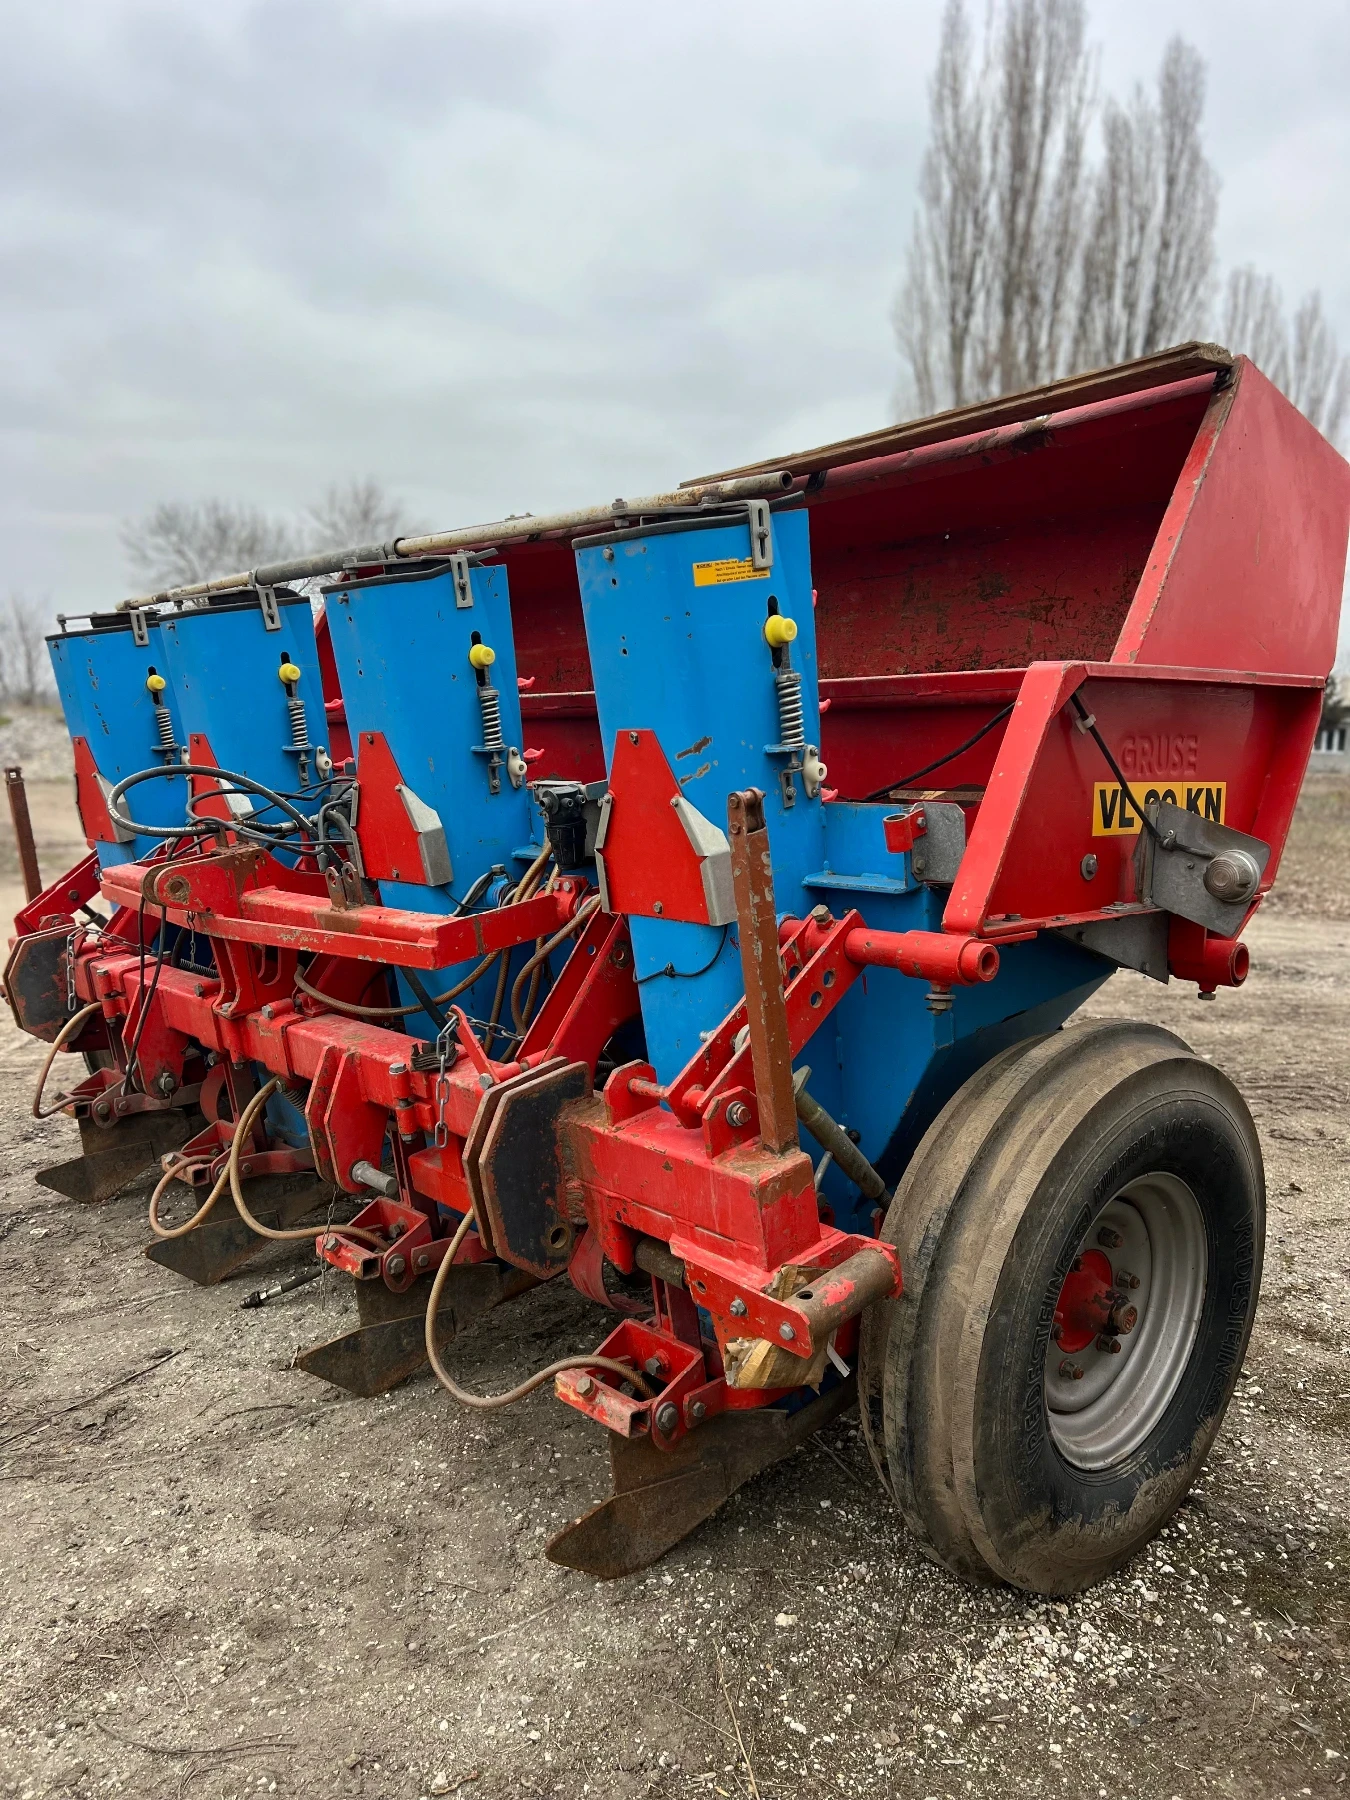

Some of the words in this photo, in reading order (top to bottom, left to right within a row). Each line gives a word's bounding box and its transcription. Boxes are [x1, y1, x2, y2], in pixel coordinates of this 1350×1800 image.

[1121, 735, 1198, 776] GRUSE
[1099, 789, 1135, 829] VL
[1186, 788, 1222, 824] KN
[1216, 1208, 1254, 1377] VREDESTEIN
